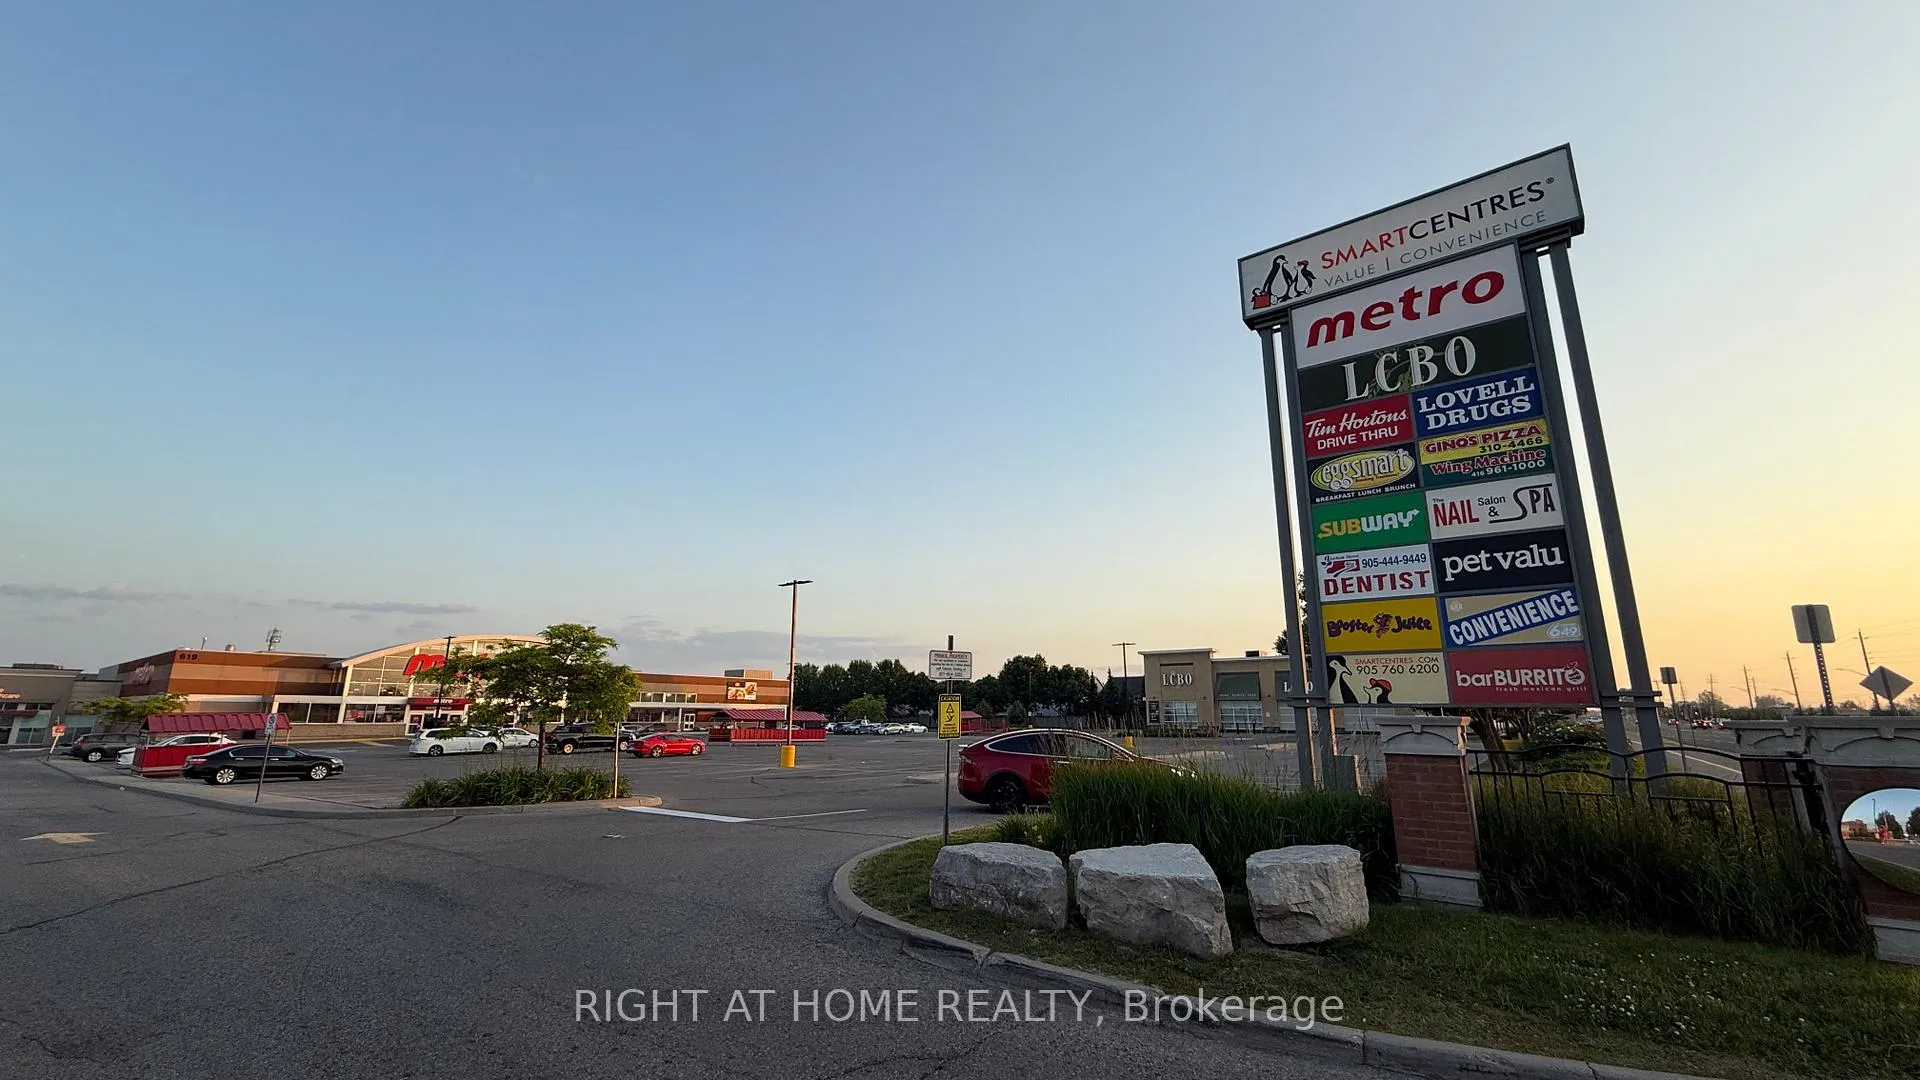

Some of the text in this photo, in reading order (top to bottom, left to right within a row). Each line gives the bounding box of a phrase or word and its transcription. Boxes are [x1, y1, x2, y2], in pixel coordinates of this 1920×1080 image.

[1324, 210, 1547, 288] VALUE CONVENIENCE
[1306, 270, 1504, 348] metro
[1342, 335, 1476, 401] LCBO
[1417, 376, 1534, 413] LOVELL
[1306, 409, 1408, 438] Tim Hortons
[1426, 395, 1531, 430] DRUGS
[1317, 426, 1398, 450] DRIVE THRU
[1425, 425, 1541, 453] GINO'S PIZZA
[1479, 437, 1543, 454] 310-4466
[1322, 448, 1409, 490] eggsmart
[1430, 449, 1546, 475] Wing Machine
[1486, 460, 1545, 475] 961-1000
[1316, 483, 1416, 503] BREAKFAST LUNCH BRUNCH
[1433, 483, 1556, 527] NAIL Salon & SPA
[1316, 509, 1420, 539] SUBWAY
[1361, 553, 1427, 568] 905-444-9449
[1442, 544, 1564, 581] pet valu
[1323, 570, 1430, 596] DENTIST
[1391, 616, 1432, 633] Juice
[1449, 590, 1580, 645] CONVENIENCE
[1162, 672, 1192, 686] LCBO
[1356, 664, 1440, 675] 905 760 6200
[1456, 667, 1586, 687] barBURRITO
